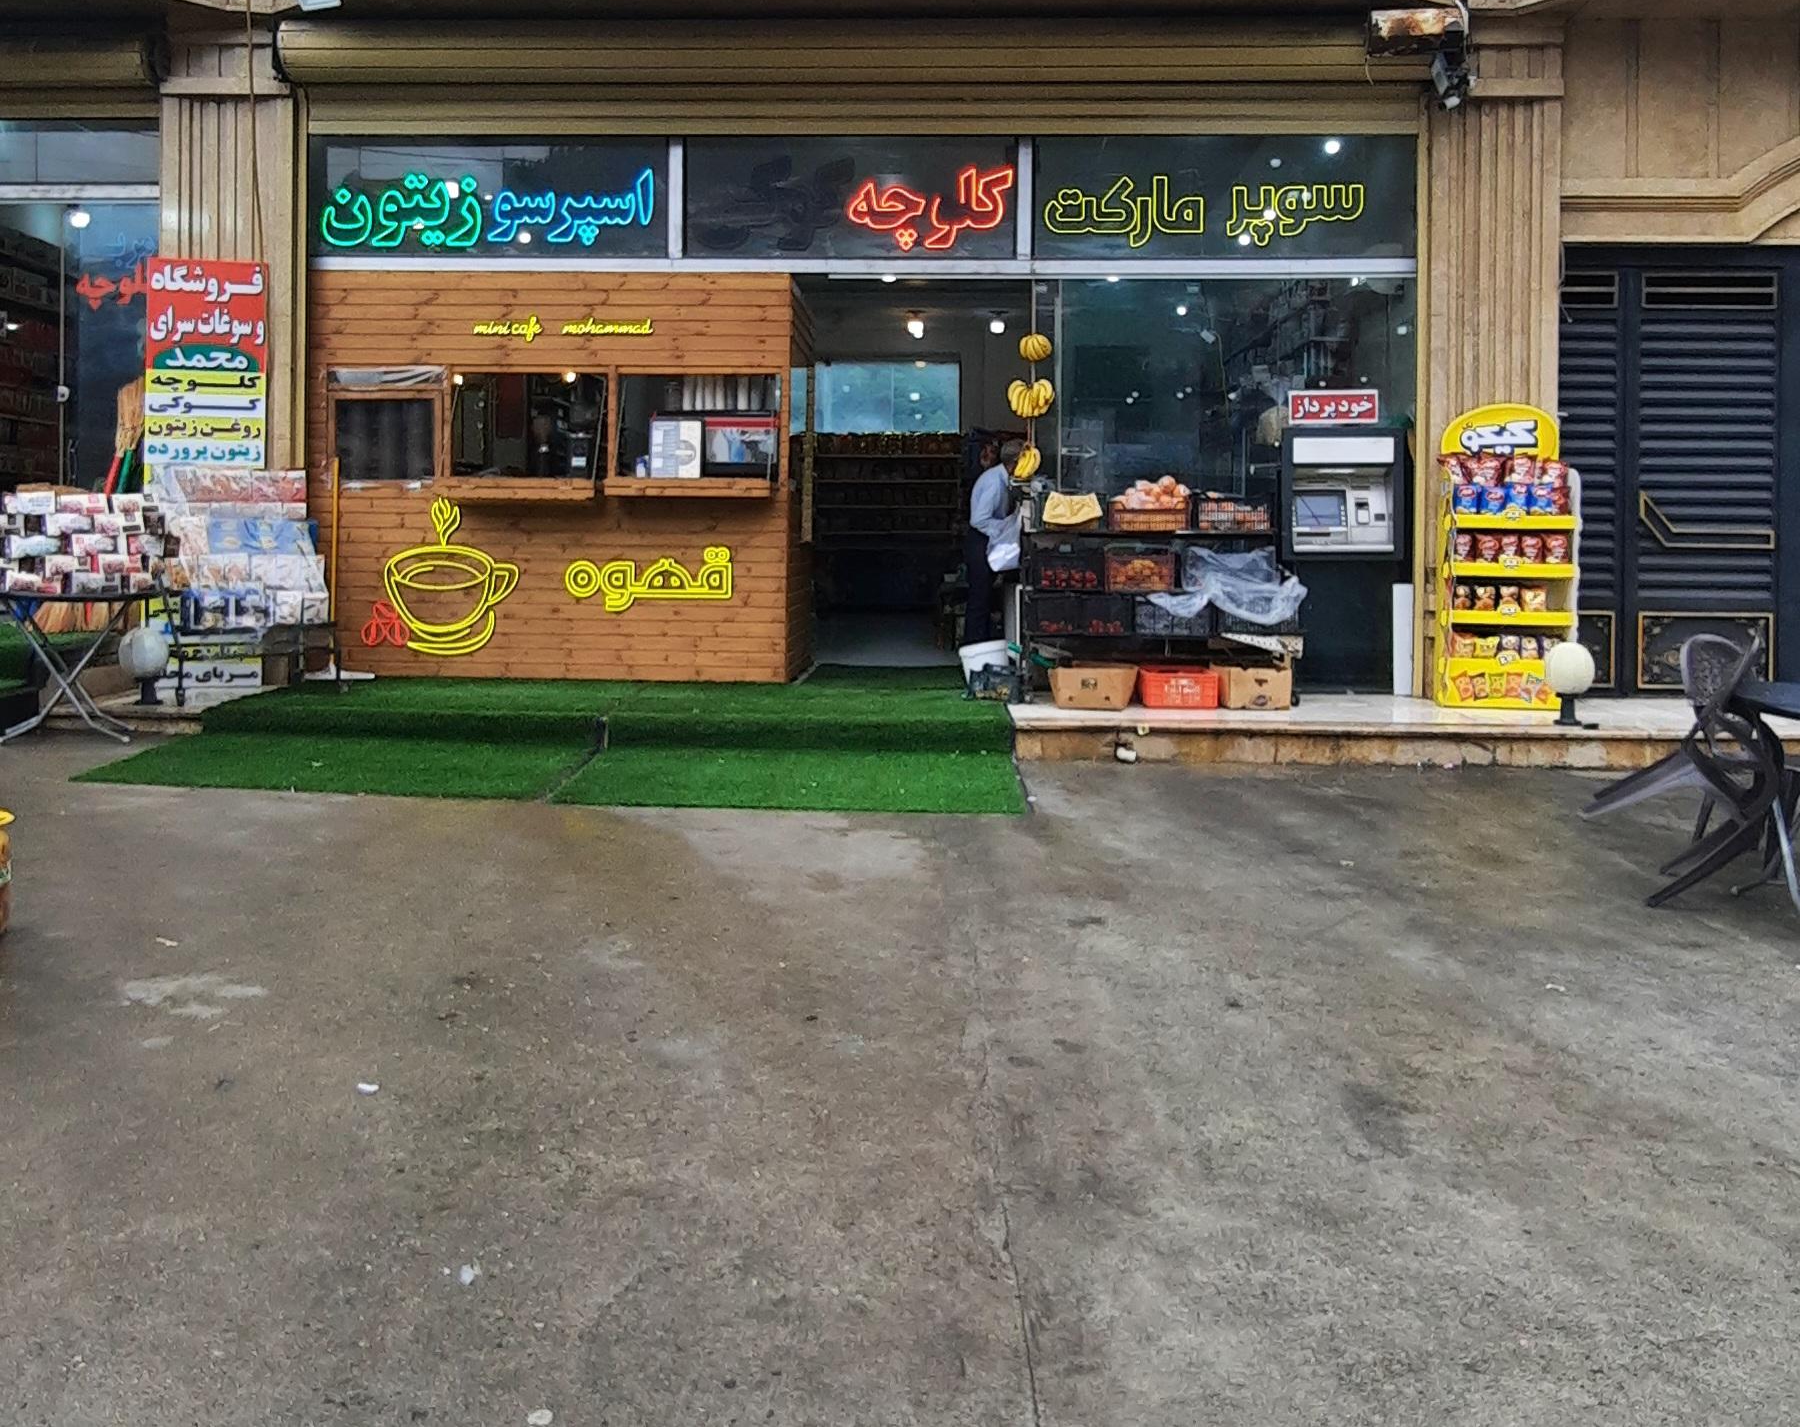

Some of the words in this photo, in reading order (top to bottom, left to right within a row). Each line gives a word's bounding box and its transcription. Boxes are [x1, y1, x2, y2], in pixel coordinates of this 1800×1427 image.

[322, 172, 483, 247] زیتون
[488, 167, 654, 246] اسپرسو
[848, 166, 1014, 252] کلوچه
[1043, 175, 1204, 248] مارکت
[1226, 184, 1365, 247] سوپر
[75, 261, 148, 311] لوچه
[151, 263, 264, 302] فروشگاه
[150, 305, 196, 342] سرای
[197, 307, 253, 344] سوغات
[254, 319, 265, 345] و
[473, 321, 510, 336] mini
[511, 315, 543, 342] cafe
[561, 317, 654, 335] mohammad
[165, 347, 249, 370] محمد
[150, 375, 262, 392] کلوچه
[148, 395, 261, 414] کوکی
[148, 418, 198, 438] زیتون
[200, 418, 261, 439] روغن
[147, 442, 208, 461] پرورده
[210, 443, 261, 462] زیتون
[565, 545, 733, 613] قهوه
